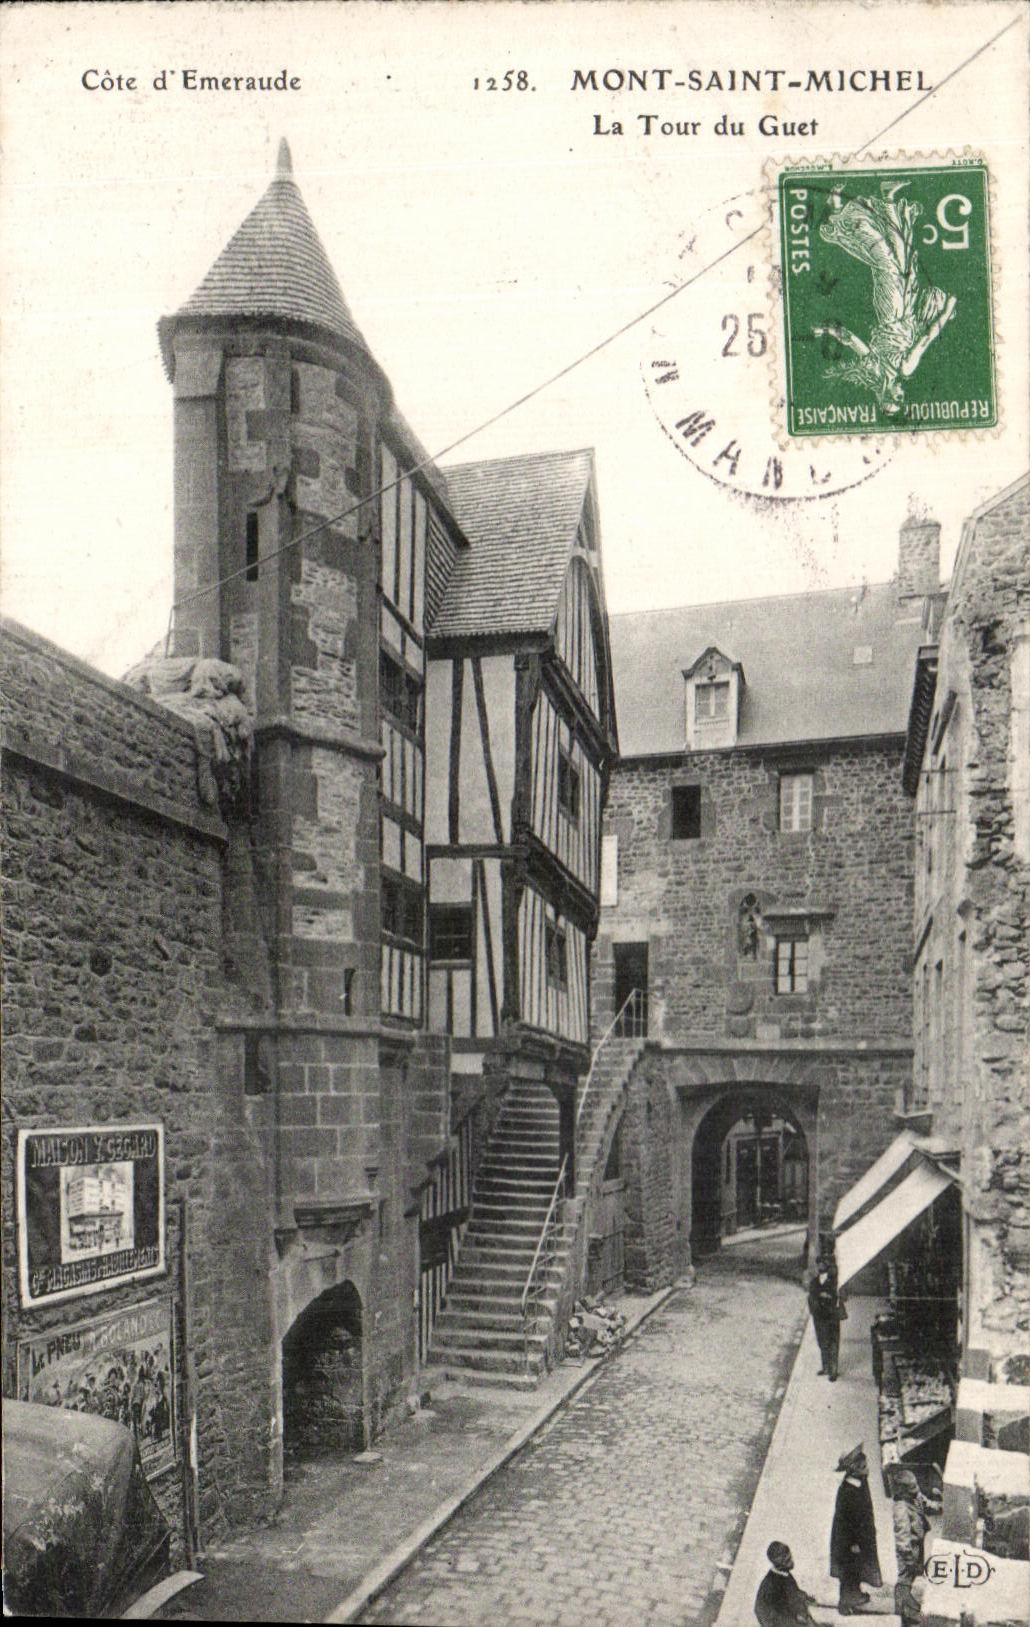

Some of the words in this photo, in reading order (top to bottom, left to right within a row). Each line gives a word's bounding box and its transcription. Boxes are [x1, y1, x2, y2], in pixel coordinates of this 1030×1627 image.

[790, 188, 809, 275] POSTES
[721, 313, 767, 357] 25
[797, 404, 876, 424] FRANÇAISE
[31, 1137, 88, 1168] MAISON
